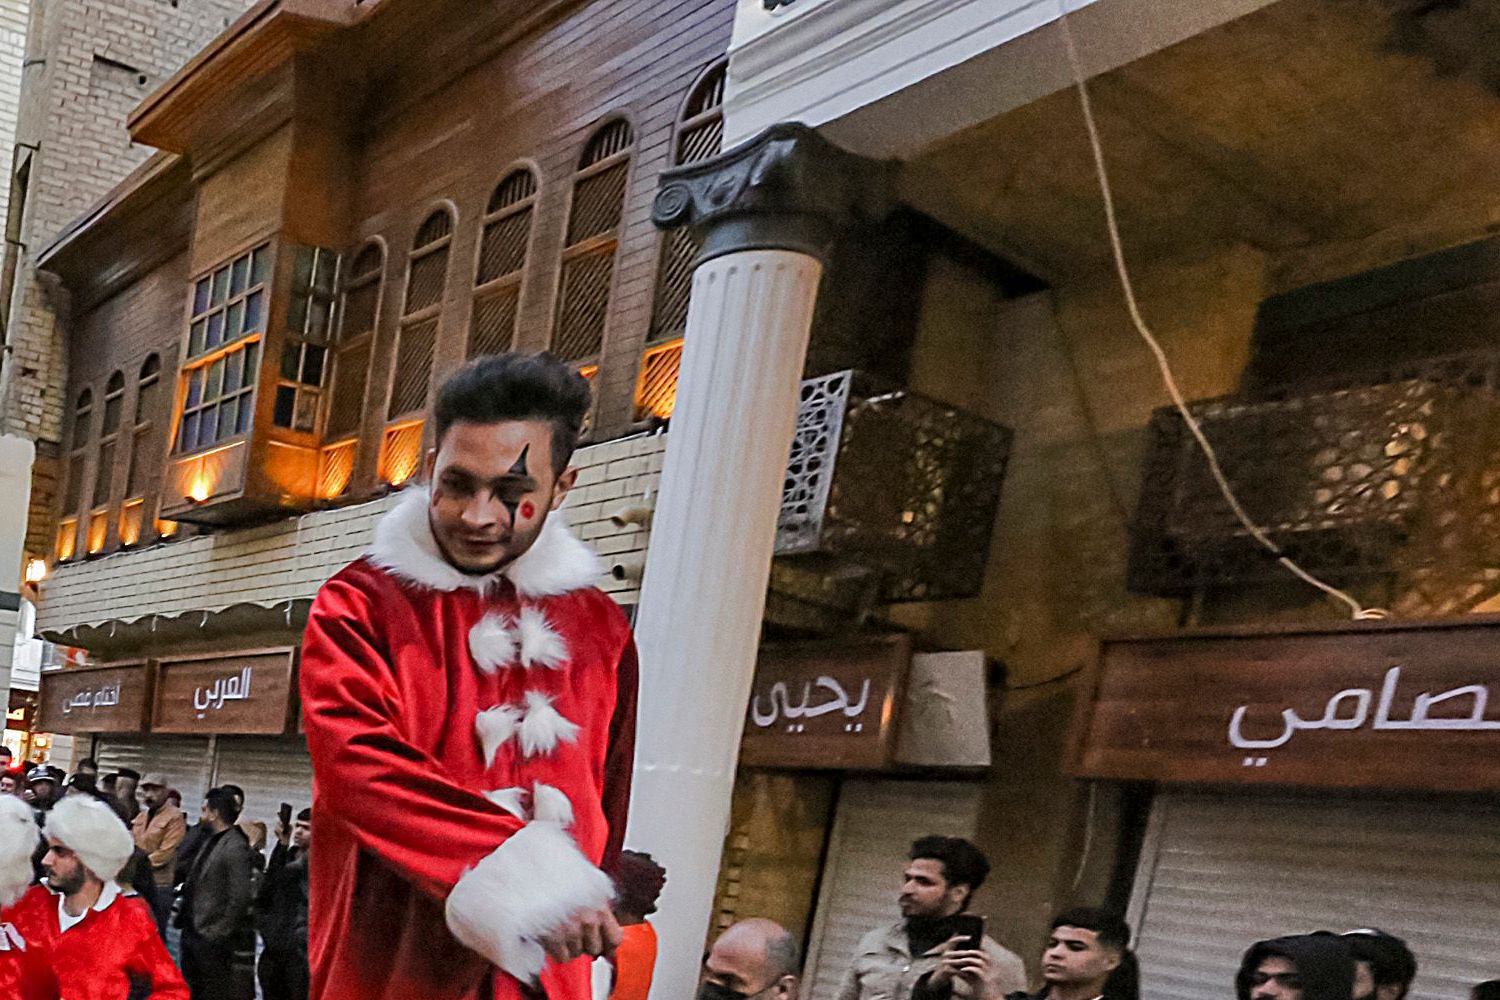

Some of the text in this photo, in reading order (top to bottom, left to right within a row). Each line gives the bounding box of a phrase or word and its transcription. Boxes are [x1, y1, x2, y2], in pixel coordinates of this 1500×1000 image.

[194, 665, 252, 720] العربي
[753, 675, 871, 732] يحيى
[1228, 665, 1500, 767] صامي
